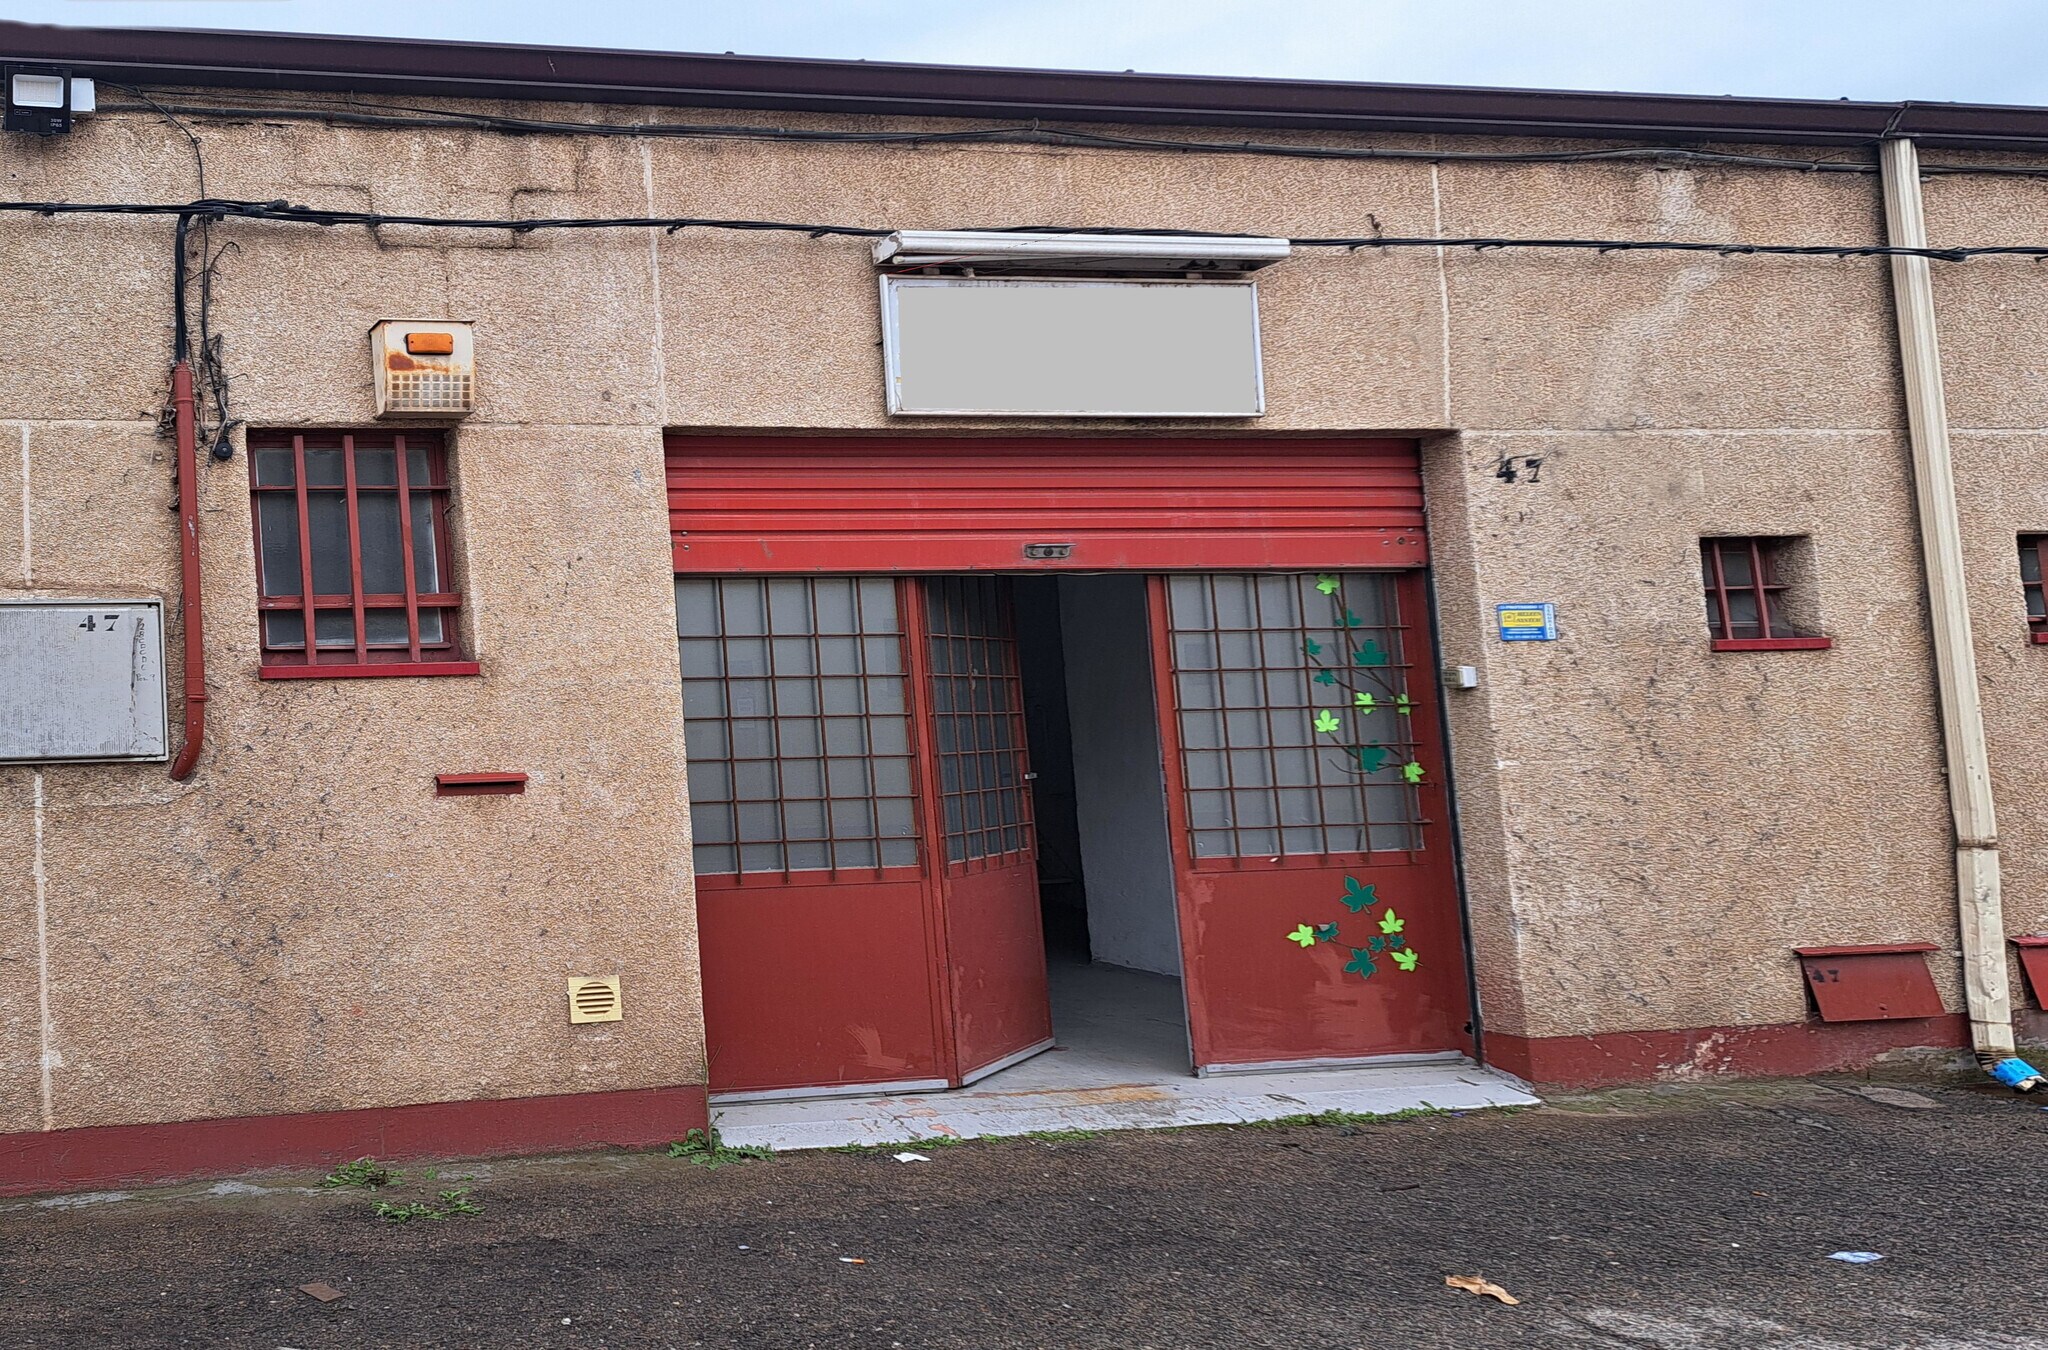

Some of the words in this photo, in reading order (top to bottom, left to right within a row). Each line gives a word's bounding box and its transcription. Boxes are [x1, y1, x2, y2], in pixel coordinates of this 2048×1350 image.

[1496, 459, 1543, 484] 47
[79, 614, 120, 632] 47
[1812, 968, 1840, 983] 47
